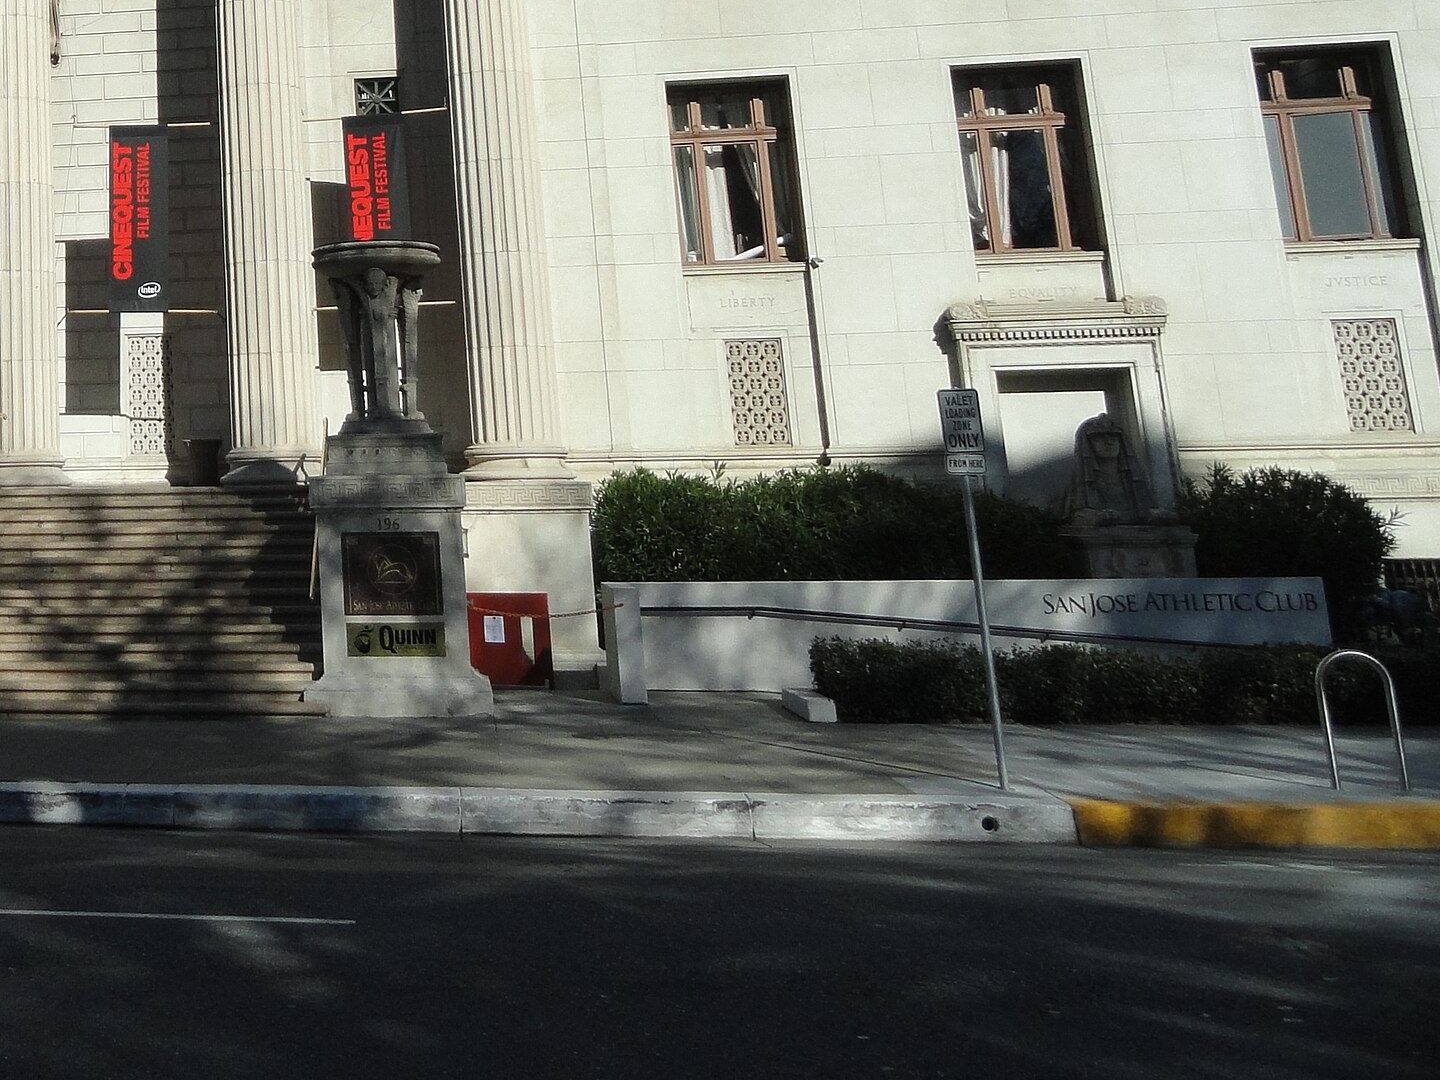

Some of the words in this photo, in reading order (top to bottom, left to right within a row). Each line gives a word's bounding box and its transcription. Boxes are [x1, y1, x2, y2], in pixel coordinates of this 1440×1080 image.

[373, 131, 389, 195] FESTIVAL
[137, 142, 151, 205] FESTIVAL
[112, 141, 134, 281] CINEQUEST
[377, 197, 391, 231] FILM
[137, 207, 150, 239] FILM
[720, 297, 775, 308] LIBERTY
[944, 395, 973, 406] VALET
[945, 408, 976, 419] LOADING
[952, 420, 972, 431] ZONE
[948, 433, 980, 448] ONLY
[948, 459, 967, 468] FROM
[968, 459, 984, 468] HERE
[377, 517, 400, 531] 196
[1042, 593, 1087, 615] SAN
[1089, 592, 1138, 617] JOSE
[1143, 591, 1254, 613] ATHLETIC
[1255, 590, 1319, 613] CLUB
